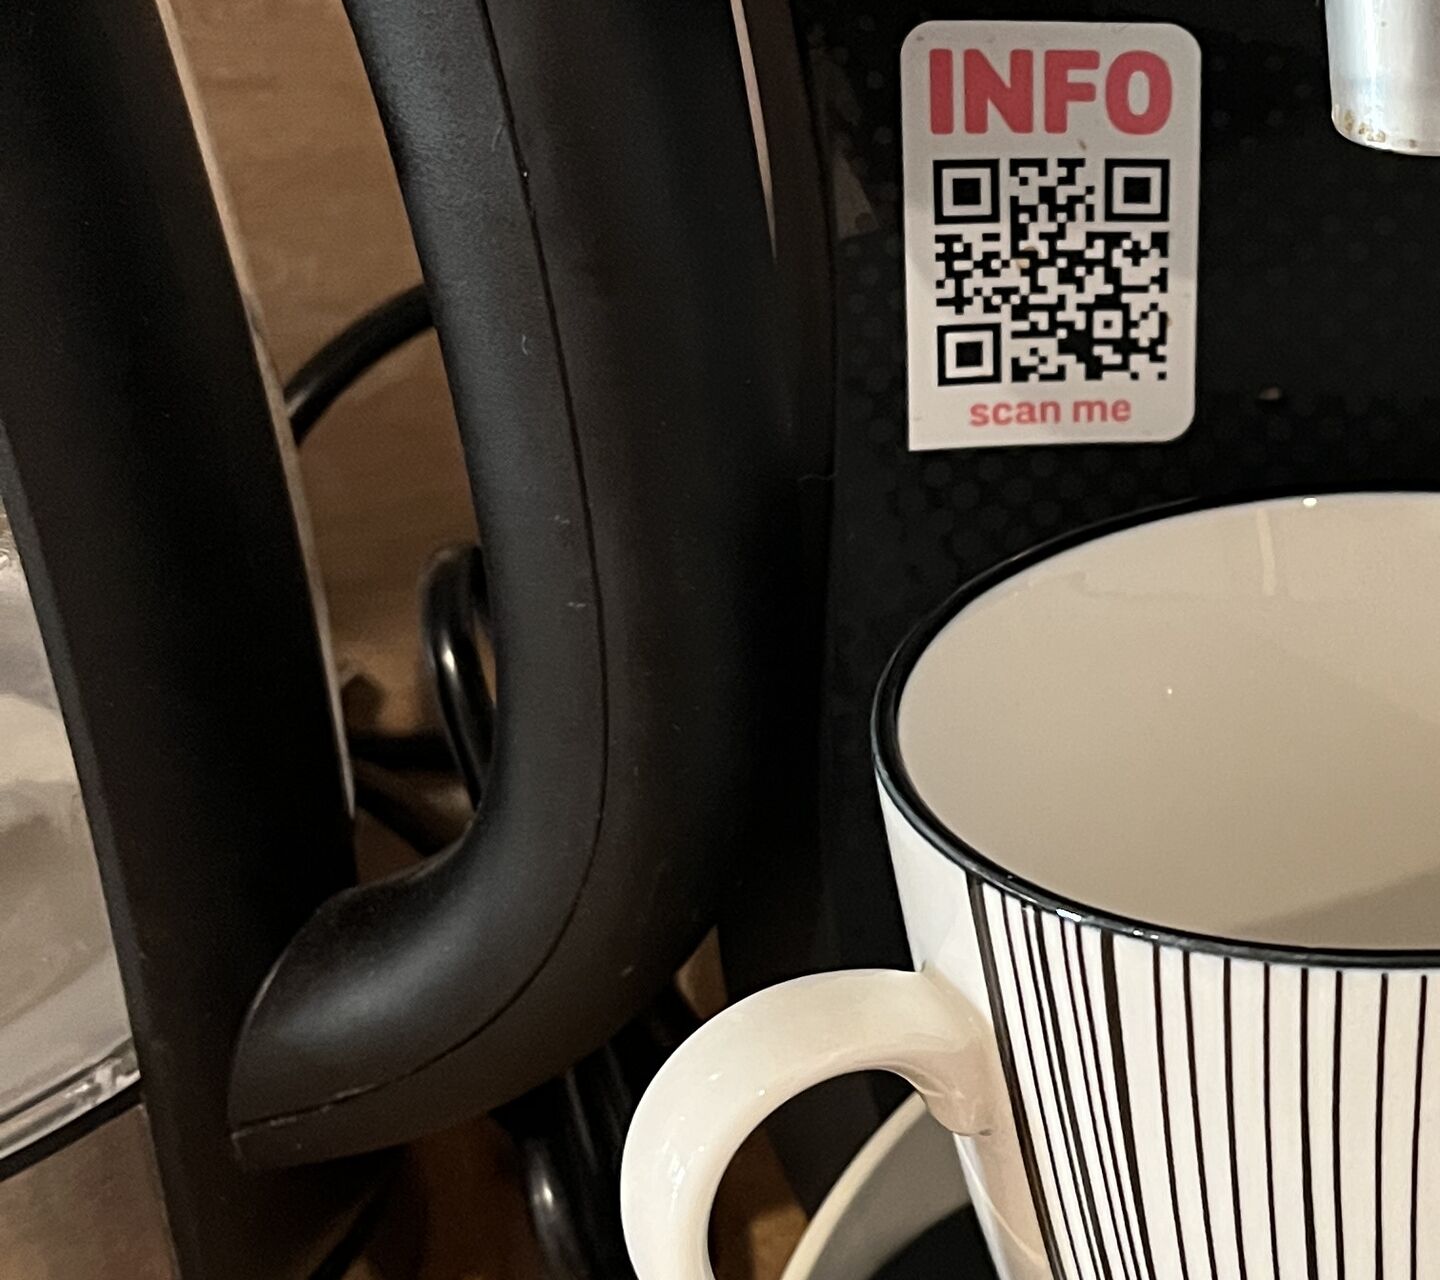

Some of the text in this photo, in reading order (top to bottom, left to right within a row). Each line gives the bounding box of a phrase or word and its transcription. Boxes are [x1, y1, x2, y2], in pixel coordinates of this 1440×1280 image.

[928, 48, 1173, 136] INFO
[967, 397, 1133, 429] scan me
